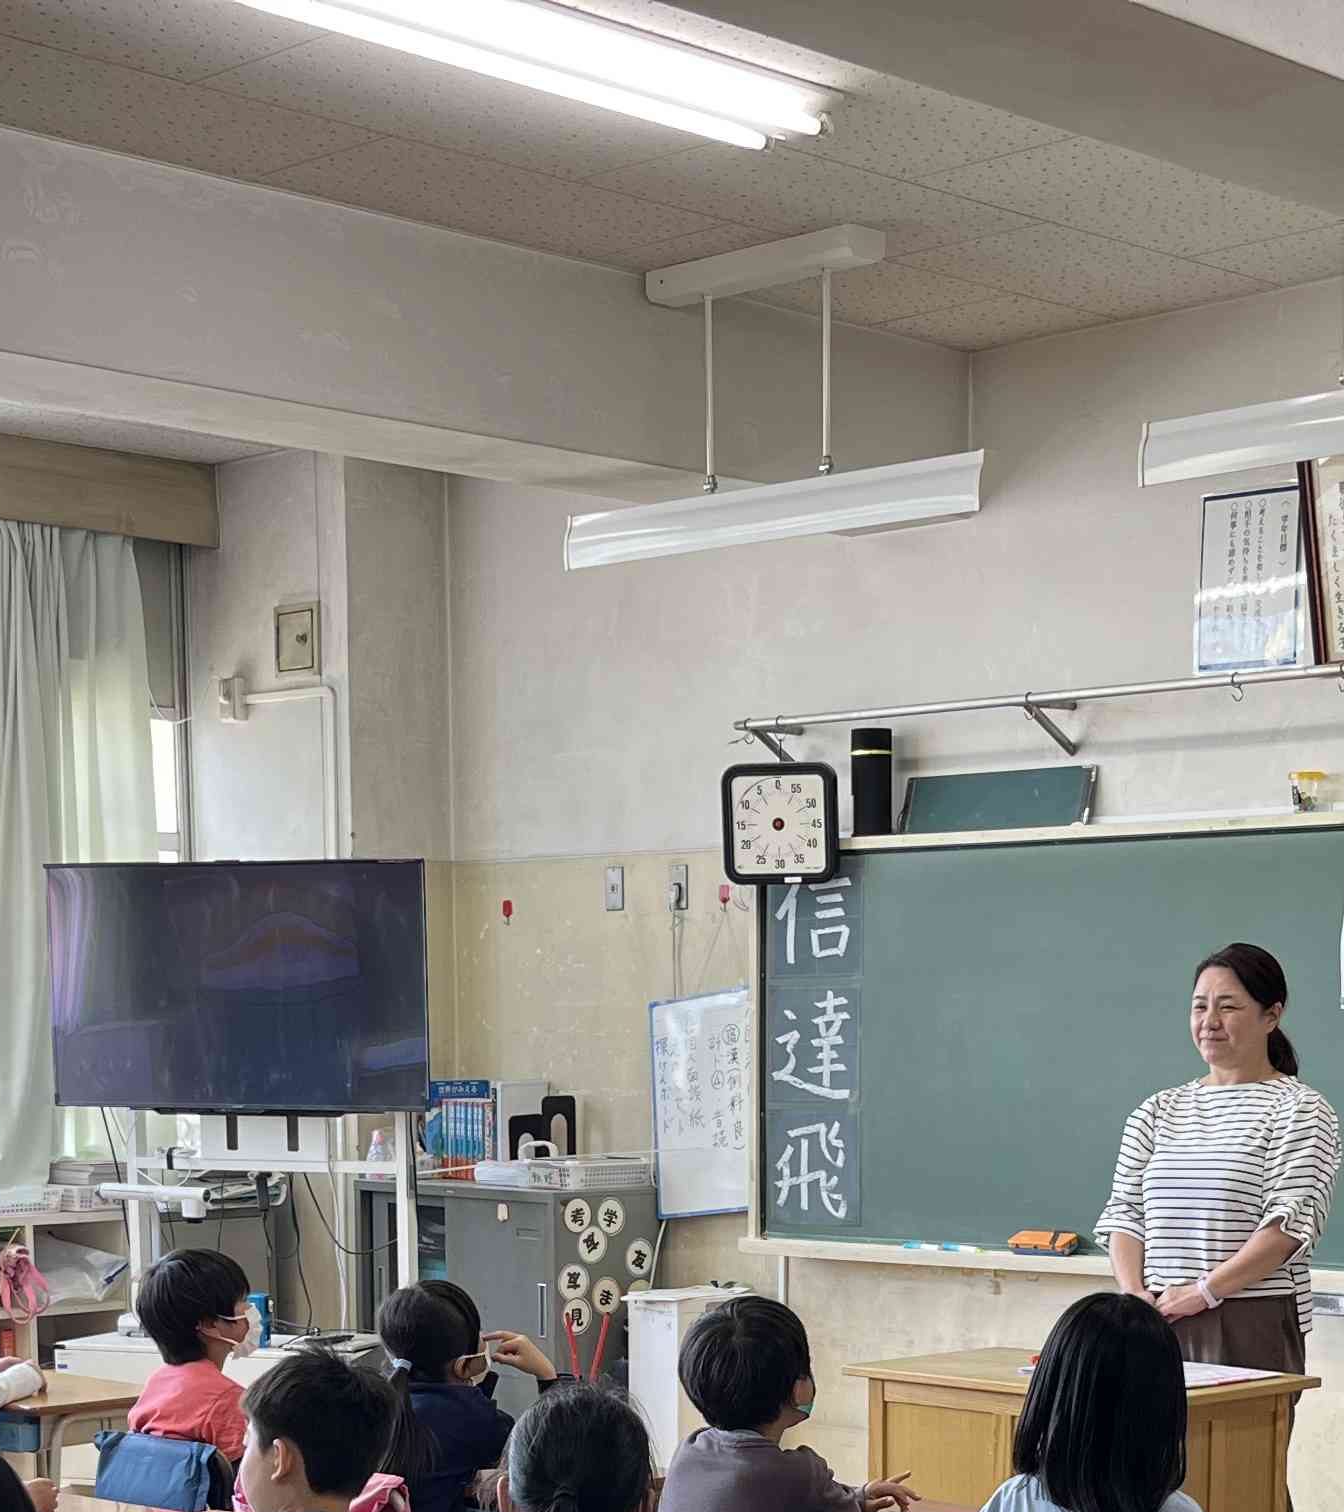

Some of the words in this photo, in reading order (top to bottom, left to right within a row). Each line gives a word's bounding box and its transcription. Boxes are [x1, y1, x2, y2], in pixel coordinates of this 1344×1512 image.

[756, 785, 762, 795] 5
[791, 784, 802, 793] 55
[741, 800, 750, 810] 10
[806, 799, 816, 808] 50
[736, 821, 746, 830] 15
[810, 818, 822, 828] 45
[741, 840, 751, 850] 20
[807, 838, 818, 848] 40
[756, 855, 767, 865] 25
[775, 859, 786, 869] 30
[794, 854, 805, 864] 35
[570, 1207, 585, 1227] 考
[603, 1208, 619, 1228] 学
